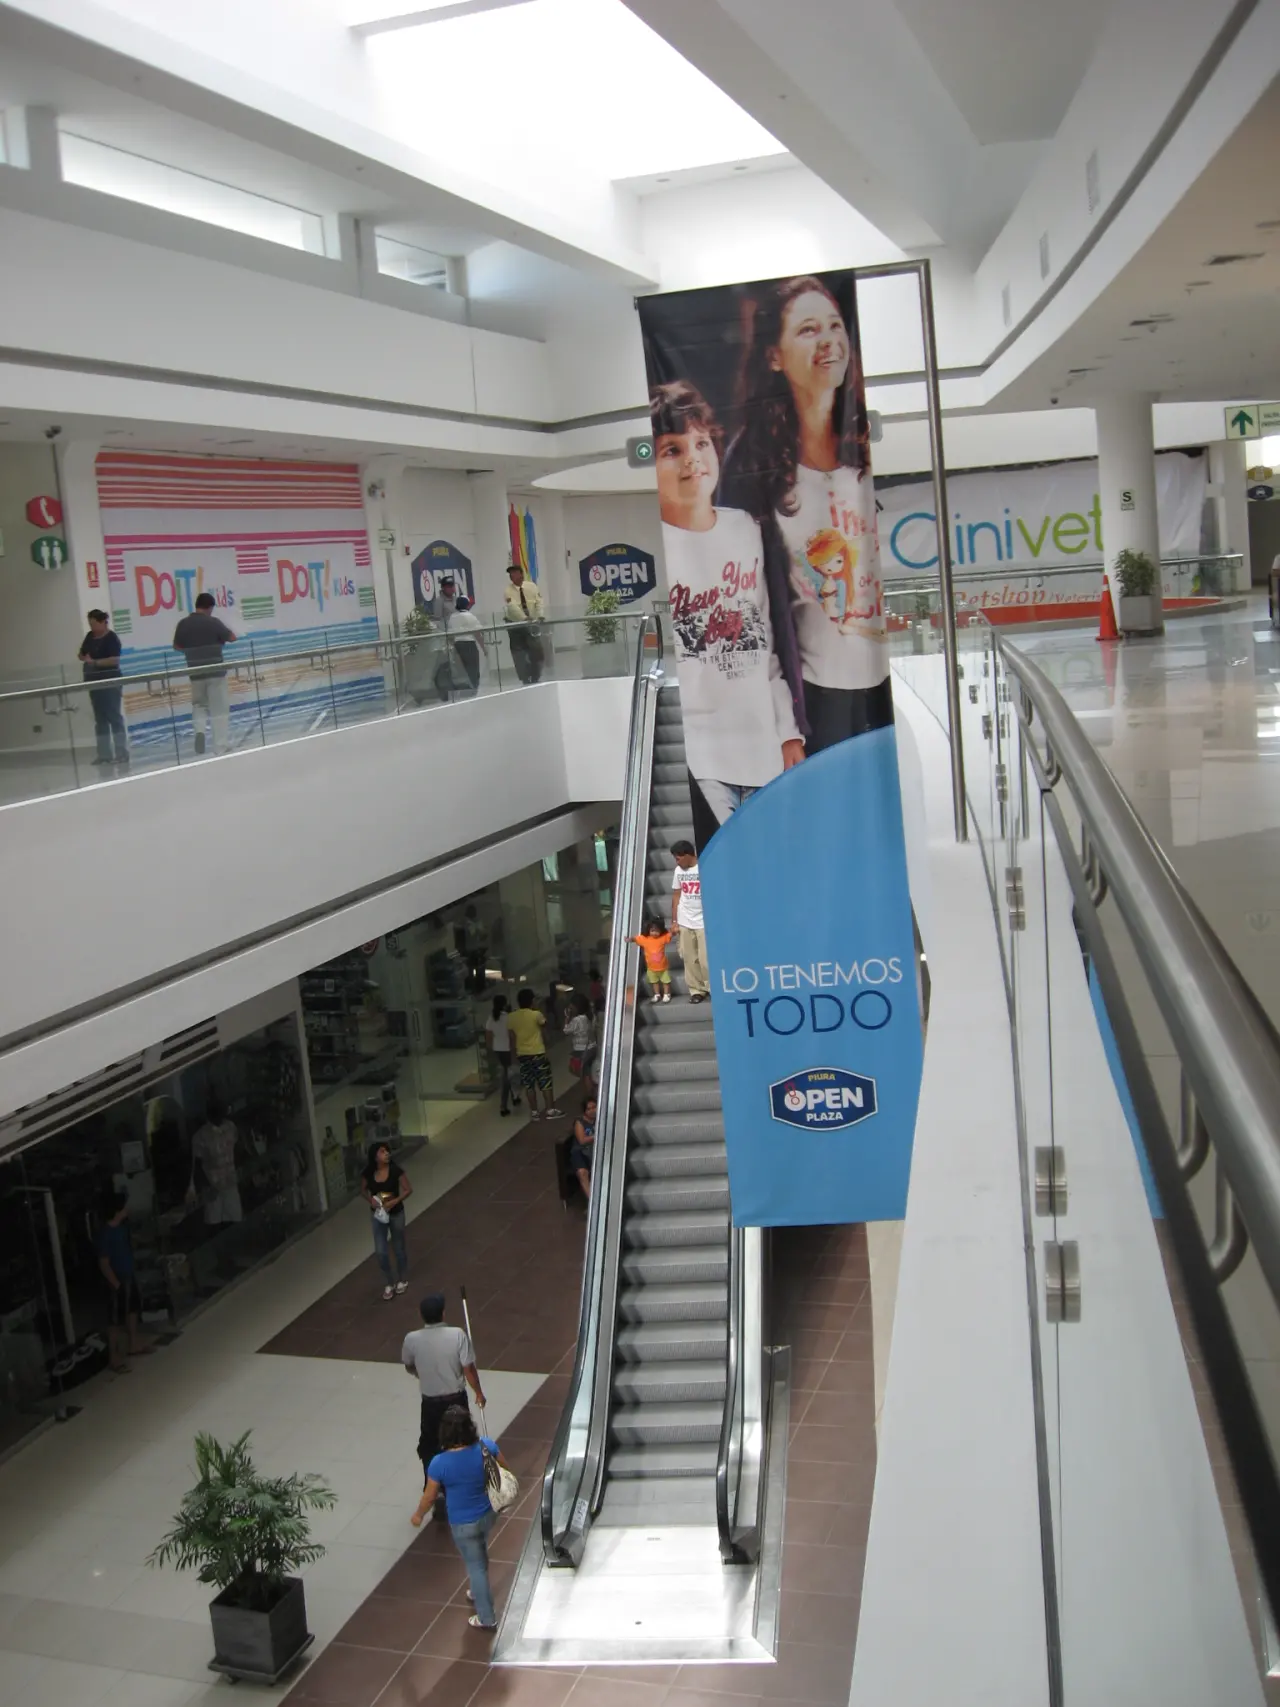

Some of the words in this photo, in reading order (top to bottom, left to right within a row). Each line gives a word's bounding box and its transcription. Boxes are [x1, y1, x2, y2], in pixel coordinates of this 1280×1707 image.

[1122, 491, 1132, 503] S
[889, 493, 1104, 570] Cinivet
[420, 568, 468, 601] OPN
[589, 562, 648, 587] OPEN
[721, 967, 758, 993] LO
[764, 957, 903, 991] TENEMOS
[737, 990, 892, 1038] TODO
[807, 1073, 836, 1082] PIURA
[784, 1086, 864, 1112] OPEN
[806, 1112, 844, 1122] PLAZA
